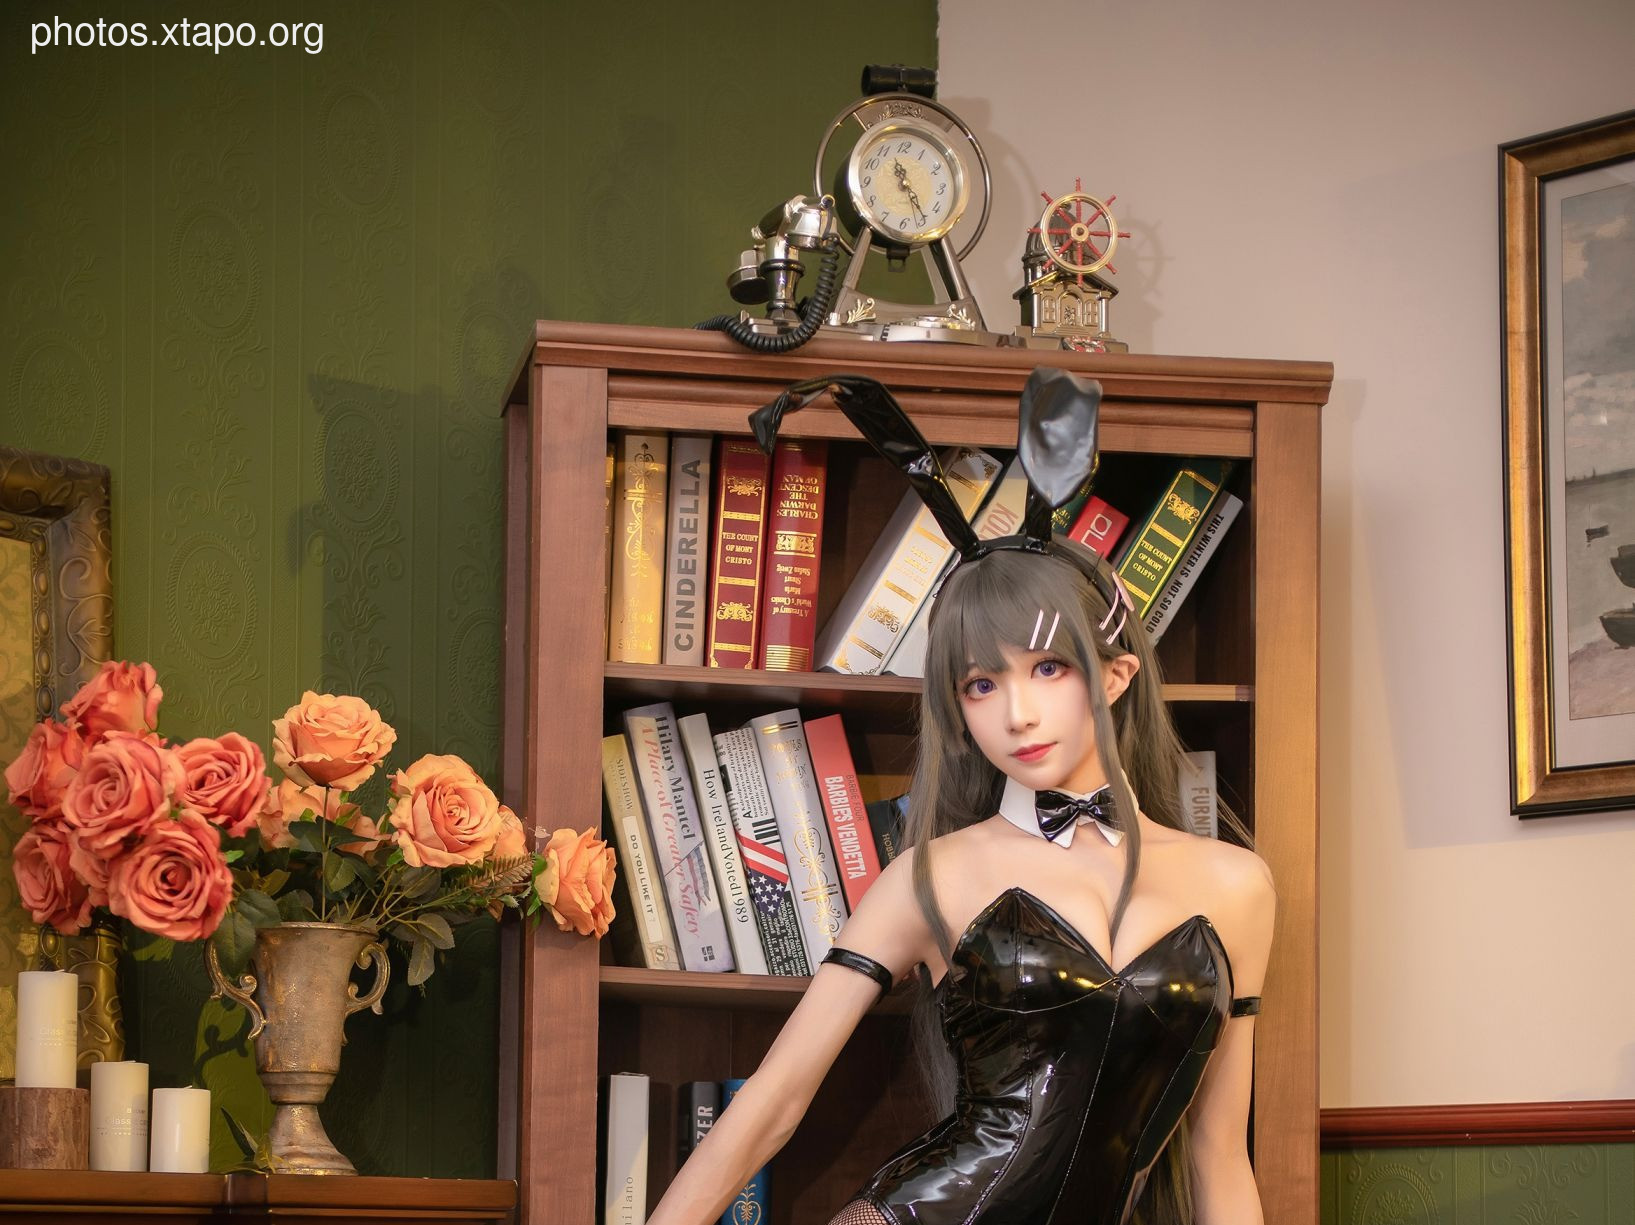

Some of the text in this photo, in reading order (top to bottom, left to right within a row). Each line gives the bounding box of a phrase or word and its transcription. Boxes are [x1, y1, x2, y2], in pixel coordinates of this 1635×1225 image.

[877, 144, 890, 157] 11
[897, 142, 912, 154] 12
[918, 149, 926, 160] 1
[865, 158, 880, 170] 10
[931, 162, 941, 176] 2
[860, 176, 871, 188] 9
[936, 183, 946, 195] 3
[866, 196, 876, 208] 8
[932, 201, 940, 214] 4
[881, 211, 890, 222] 7
[900, 218, 910, 230] 6
[783, 474, 804, 483] MAN
[778, 484, 819, 494] DESCENT
[790, 492, 808, 500] THE
[780, 500, 816, 510] DARWIN
[776, 509, 818, 519] CHARLES
[979, 502, 1019, 540] KOL
[735, 545, 754, 553] MONT
[674, 460, 701, 652] CINDERELLA
[725, 556, 752, 565] CRISTO
[1138, 552, 1163, 572] OF MONT
[1152, 548, 1172, 564] COUNT
[1132, 562, 1156, 582] CRISTO
[1145, 514, 1224, 634] THIS WINTER IS NOT SO COLD
[644, 740, 663, 788] Place
[616, 758, 633, 810] SIDESHOW
[655, 716, 696, 840] Hilary Mantel
[703, 769, 718, 800] How
[658, 790, 672, 809] of
[742, 811, 753, 820] A
[824, 776, 867, 880] BARBIES VENDETTA
[630, 834, 639, 850] DO
[662, 812, 686, 881] Greater
[634, 852, 644, 873] YOU
[640, 875, 650, 899] LIKE
[646, 903, 654, 914] IT
[679, 882, 700, 938] Safety
[697, 1105, 713, 1147] ZER
